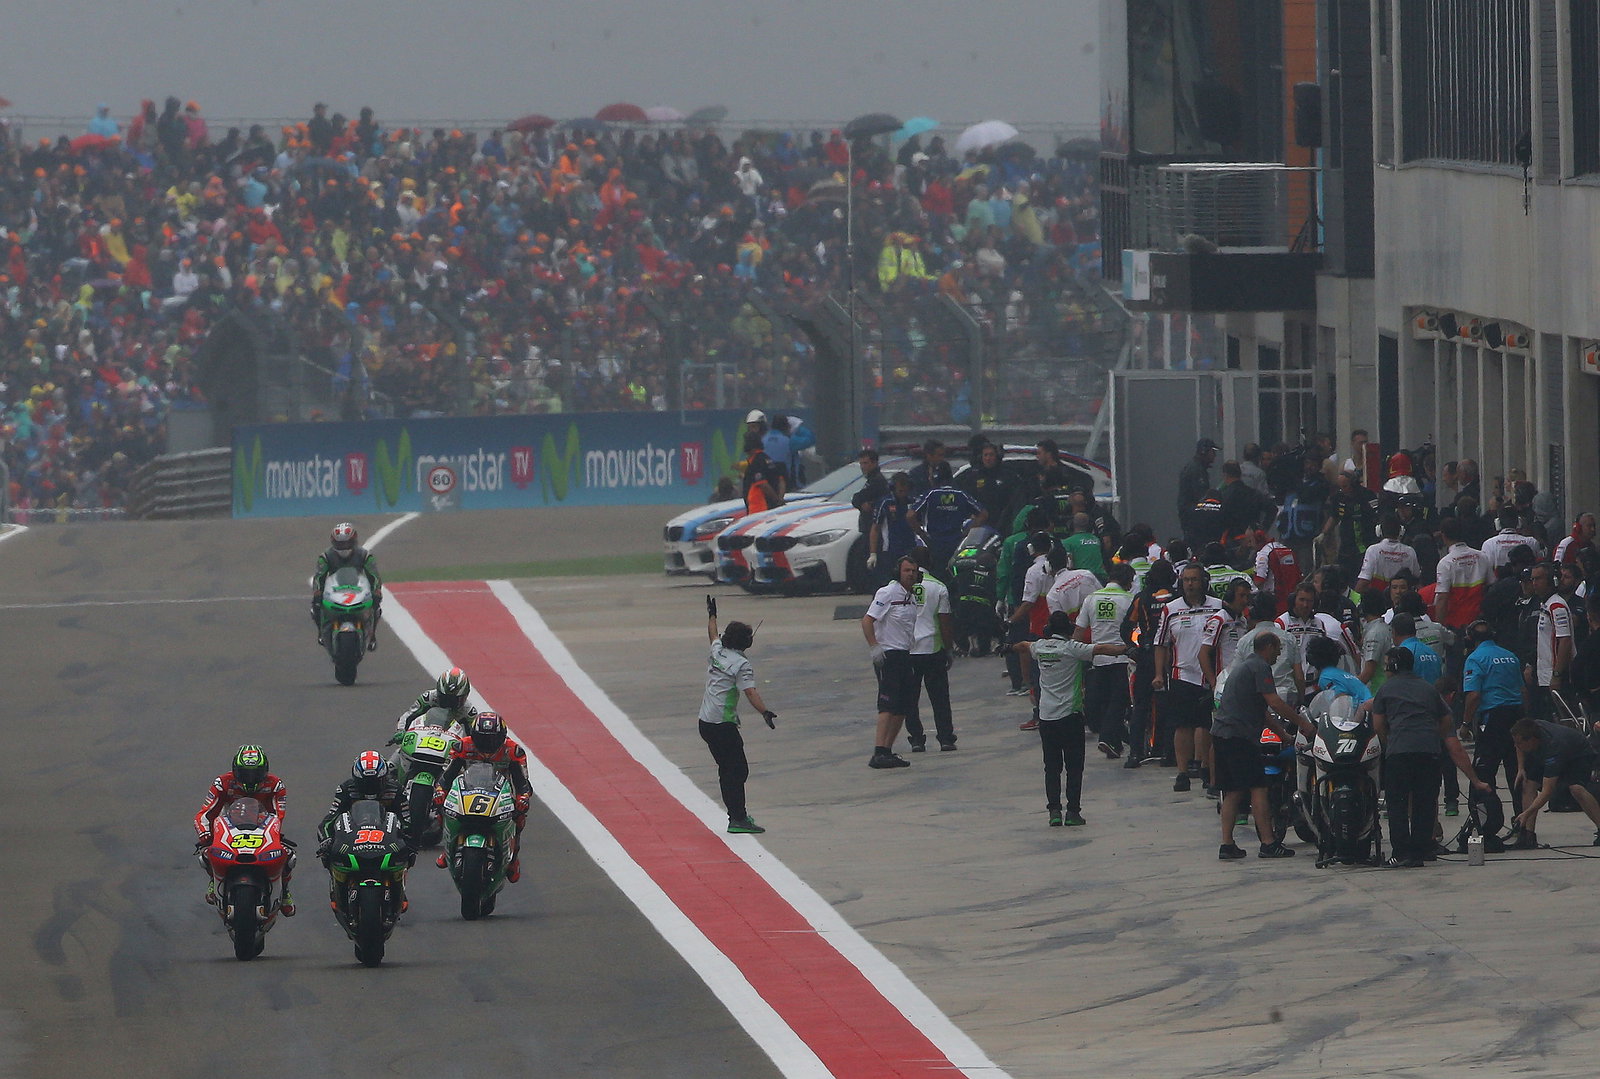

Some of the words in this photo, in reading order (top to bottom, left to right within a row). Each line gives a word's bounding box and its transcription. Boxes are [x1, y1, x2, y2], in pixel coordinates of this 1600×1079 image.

[416, 447, 505, 493] mistar
[514, 451, 529, 476] TV
[585, 442, 676, 489] movistar
[684, 447, 699, 472] TV
[265, 453, 342, 499] movistar
[350, 458, 364, 483] TV
[432, 474, 451, 486] 60
[1098, 601, 1114, 612] GO
[417, 736, 447, 752] 19
[1336, 738, 1358, 754] 70
[468, 795, 491, 813] 6
[229, 834, 264, 848] 35
[354, 829, 385, 844] 38
[220, 851, 233, 860] TIM
[269, 849, 282, 859] TIM
